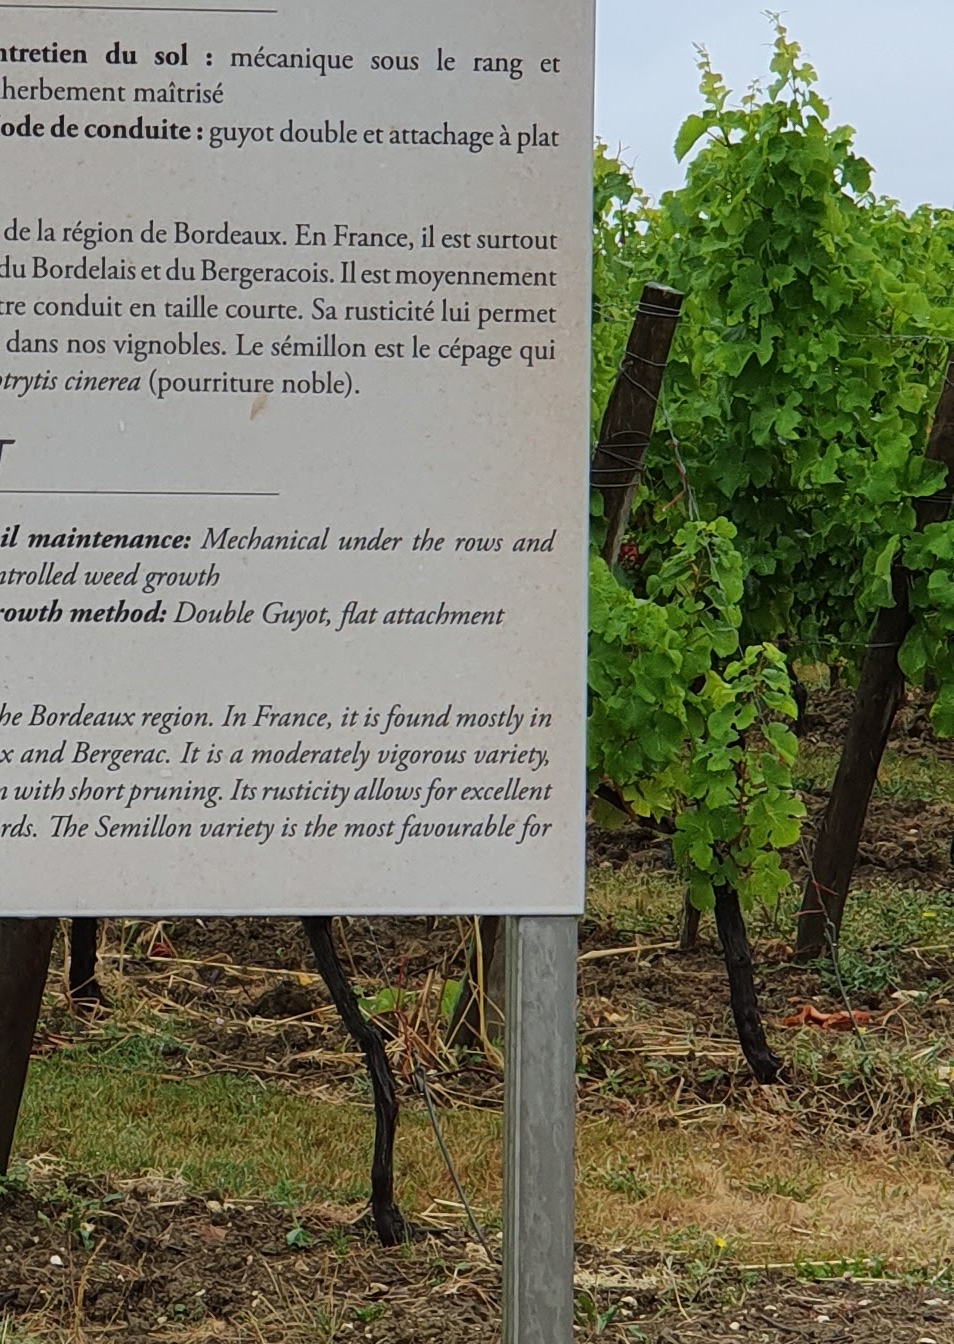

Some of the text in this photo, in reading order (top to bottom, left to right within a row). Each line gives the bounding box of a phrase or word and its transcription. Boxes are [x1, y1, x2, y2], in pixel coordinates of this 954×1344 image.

[105, 41, 137, 64] du
[154, 43, 188, 65] sol
[230, 46, 353, 76] mécanique
[370, 55, 418, 71] sous
[436, 48, 456, 71] le
[473, 58, 523, 80] rang
[540, 57, 560, 74] et
[133, 81, 223, 103] maîtrisé
[50, 114, 78, 137] de
[84, 116, 191, 140] conduite
[209, 127, 274, 148] guyot
[279, 119, 357, 143] double
[363, 128, 383, 145] et
[389, 122, 493, 153] attachage
[499, 125, 512, 146] à
[517, 123, 559, 154] plat
[3, 218, 30, 241] de
[36, 218, 56, 241] la
[62, 221, 133, 250] région
[140, 220, 166, 243] de
[174, 221, 286, 245] Bordeaux.
[294, 224, 326, 245] En
[333, 224, 413, 250] France,
[421, 225, 435, 247] il
[441, 232, 471, 249] est
[476, 233, 557, 250] surtout
[31, 256, 135, 280] Bordelais
[140, 264, 161, 281] et
[165, 258, 195, 281] du
[201, 259, 334, 289] Bergeracois.
[340, 260, 357, 283] Il
[360, 268, 391, 285] est
[395, 270, 556, 291] moyennement
[33, 293, 122, 317] conduit
[129, 302, 156, 318] en
[164, 295, 218, 318] taille
[225, 303, 302, 320] courte.
[311, 298, 337, 320] Sa
[344, 300, 434, 321] rusticité
[441, 298, 470, 321] lui
[478, 308, 556, 330] permet
[64, 370, 141, 391] cinerea
[148, 369, 274, 399] (pourriture
[281, 371, 359, 398] noble).
[27, 527, 191, 549] maintenance:
[199, 526, 330, 550] Mechanical
[338, 528, 403, 550] under
[411, 528, 445, 551] the
[454, 537, 503, 552] rows
[512, 529, 557, 552] and
[84, 562, 141, 585] weed
[142, 563, 220, 593] growth
[69, 600, 167, 623] method:
[172, 600, 254, 623] Double
[262, 602, 331, 631] Guyot,
[336, 601, 378, 632] flat
[382, 602, 505, 625] attachment
[19, 740, 67, 763] and
[70, 742, 169, 771] Bergerac.
[179, 742, 200, 763] It
[206, 743, 224, 763] is
[229, 748, 244, 764] a
[250, 741, 370, 771] moderately
[377, 744, 466, 772] vigorous
[473, 744, 549, 771] variety,
[50, 814, 88, 837] The
[94, 814, 191, 837] Semillon
[199, 817, 275, 845] variety
[280, 817, 298, 837] is
[303, 814, 337, 837] the
[343, 820, 396, 838] most
[397, 814, 517, 844] favourable
[514, 814, 552, 844] for
